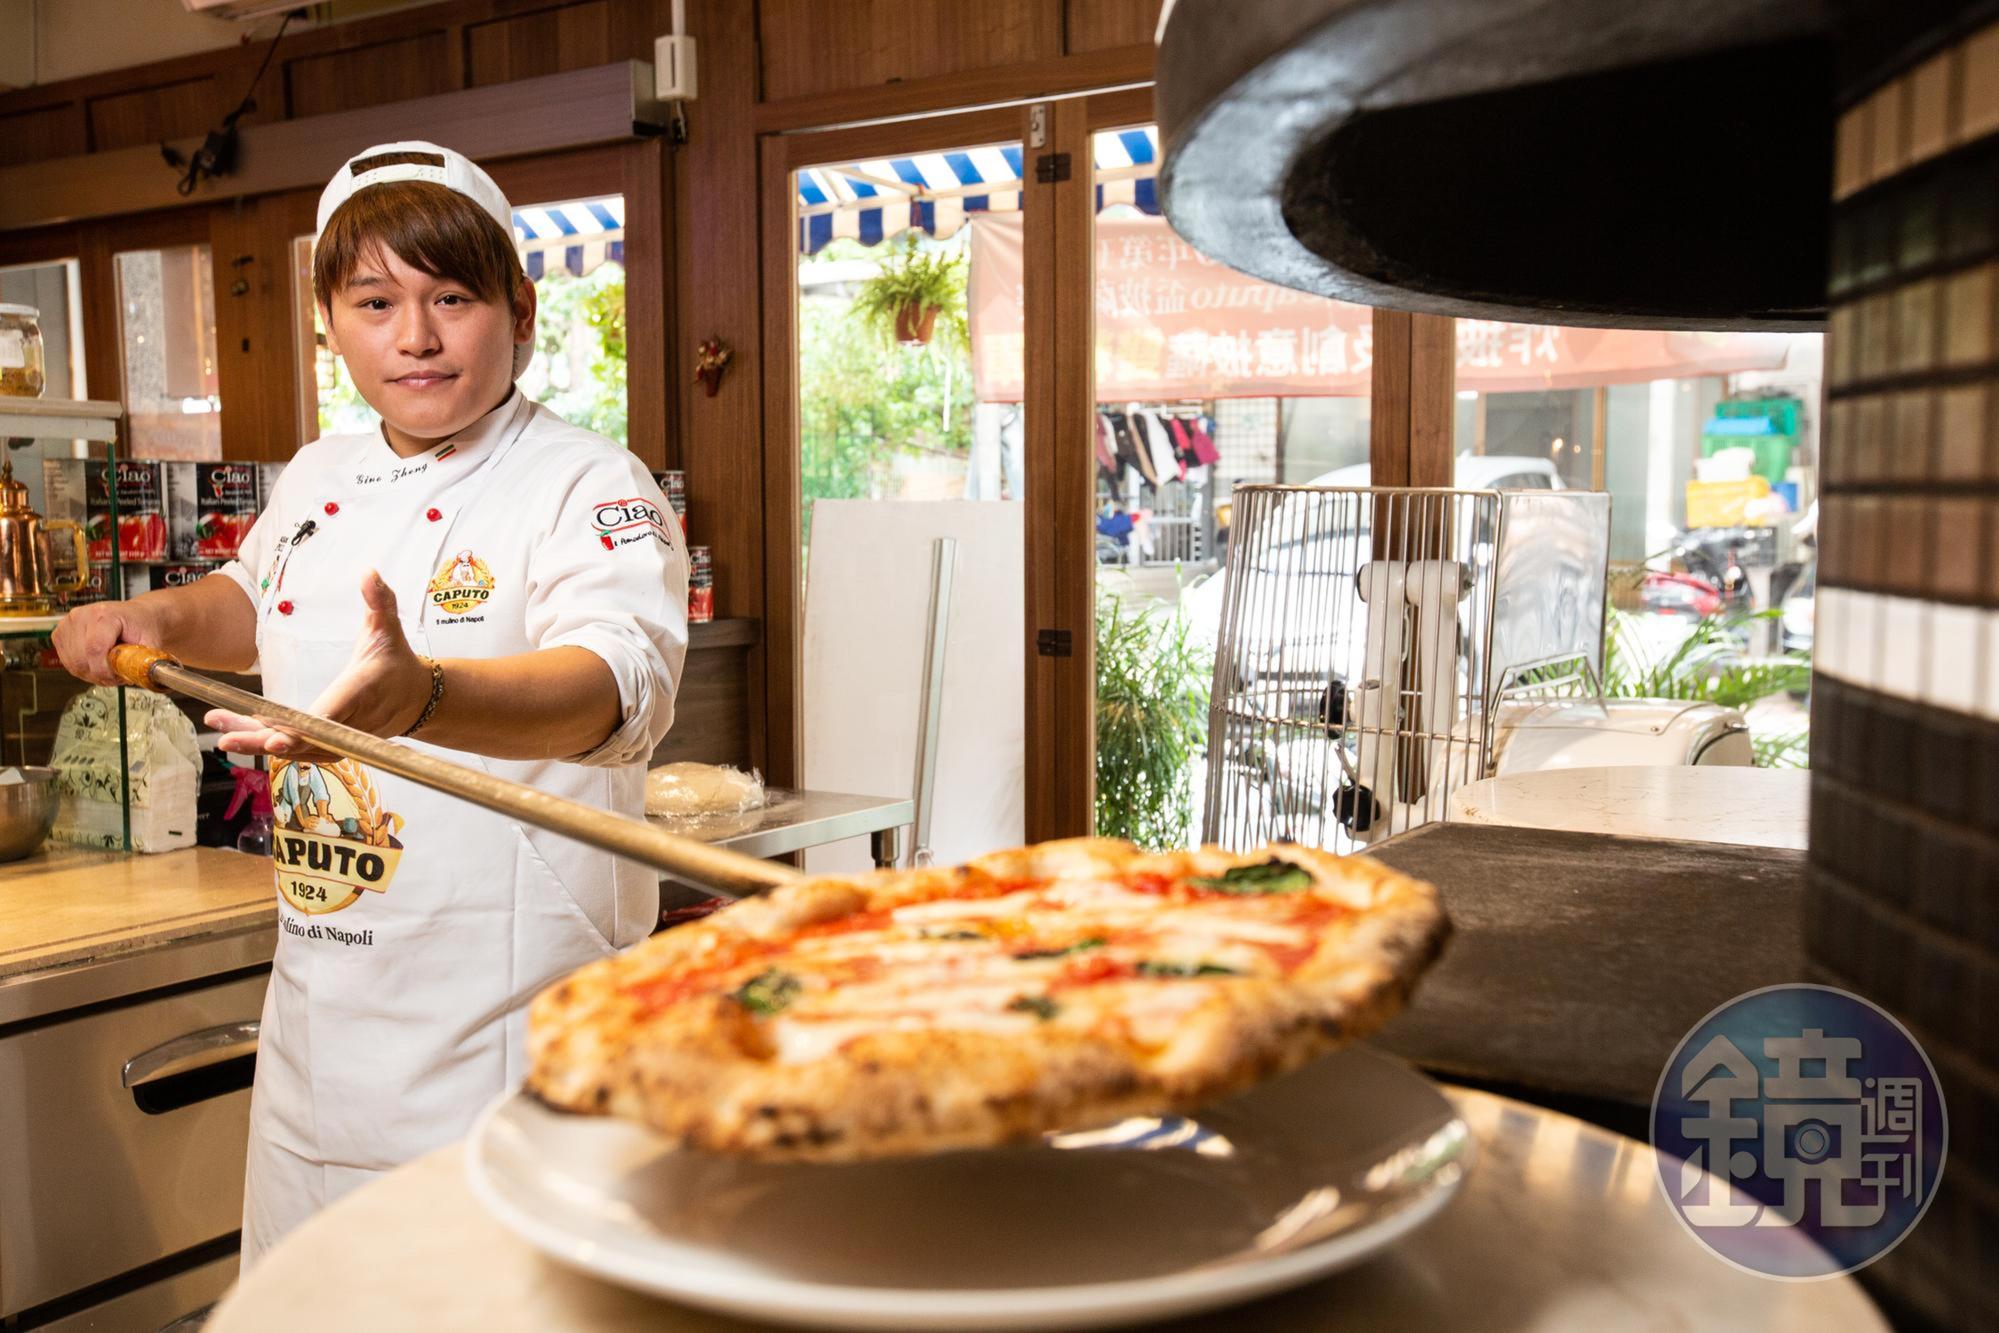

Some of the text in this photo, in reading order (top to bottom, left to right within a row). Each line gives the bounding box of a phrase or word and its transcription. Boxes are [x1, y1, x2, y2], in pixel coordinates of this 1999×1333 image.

[211, 466, 250, 484] Ciao
[596, 500, 663, 527] Ciao
[433, 589, 489, 603] CAPUTO
[451, 602, 469, 610] 1924
[273, 835, 385, 882] APUTO
[291, 880, 327, 902] 1924
[307, 925, 322, 939] di
[325, 926, 374, 946] Napoli
